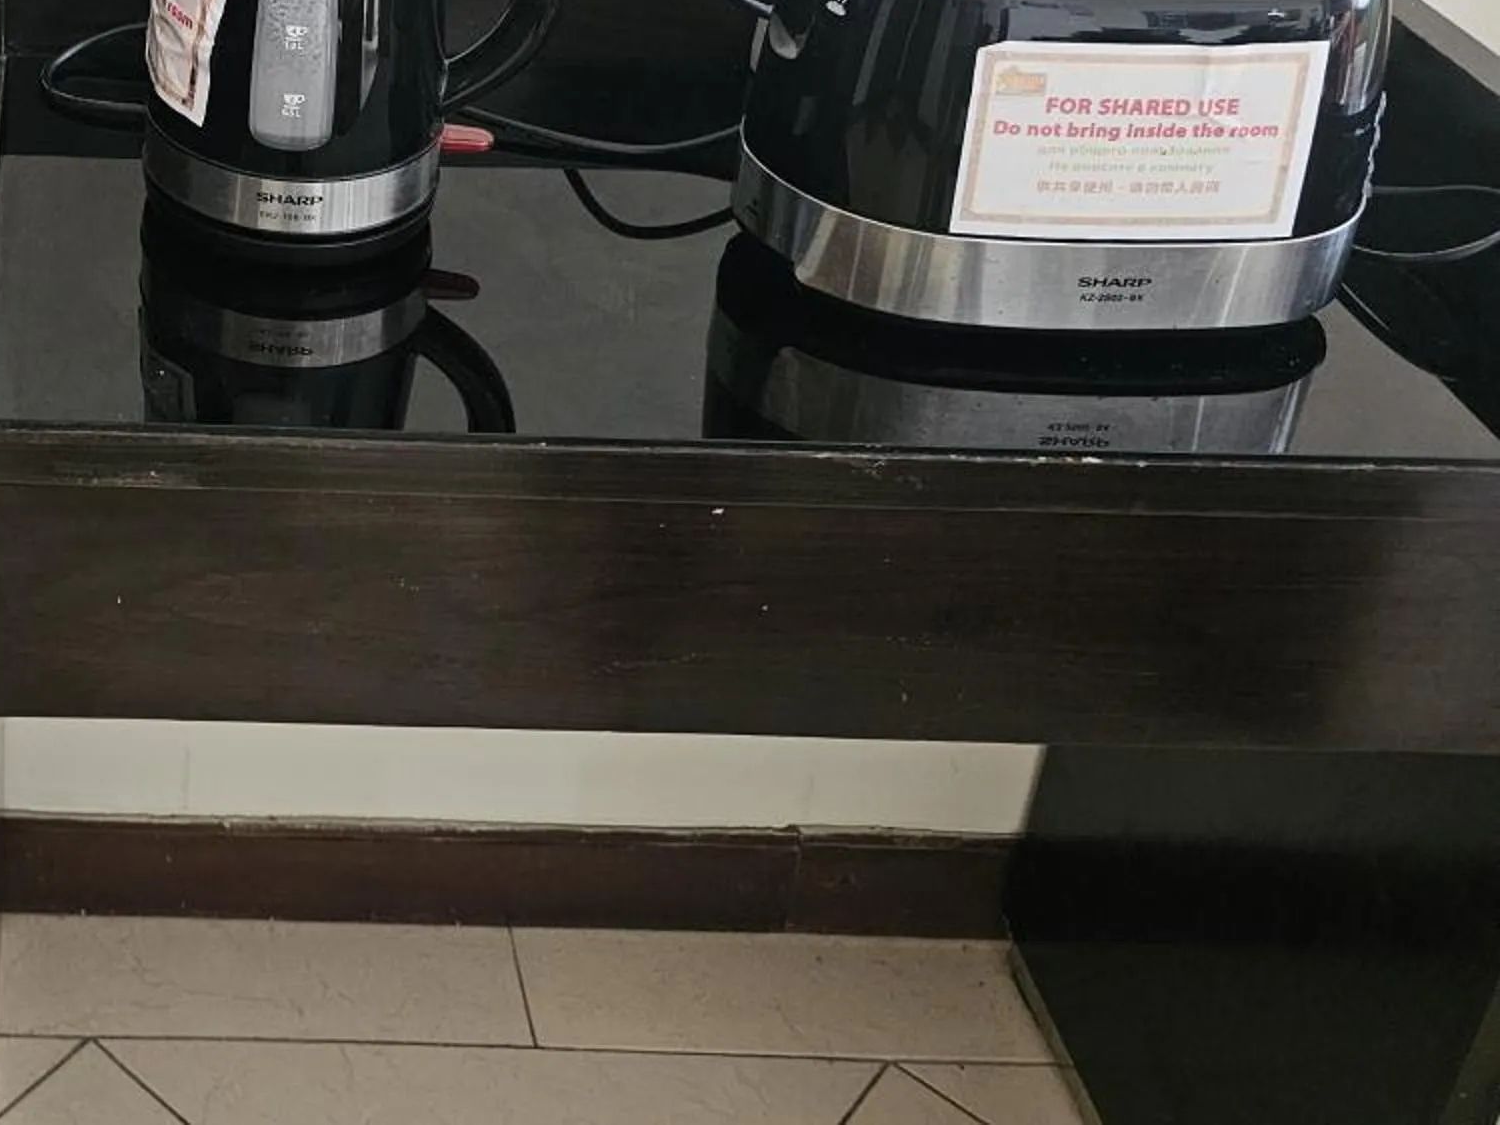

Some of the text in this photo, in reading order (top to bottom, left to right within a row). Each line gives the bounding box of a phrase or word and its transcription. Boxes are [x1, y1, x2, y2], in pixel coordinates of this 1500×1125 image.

[1045, 97, 1241, 116] FOR SHARED USE
[992, 121, 1279, 141] Do not bring inside the room
[256, 191, 323, 205] SHARP
[1077, 276, 1153, 287] SHARP
